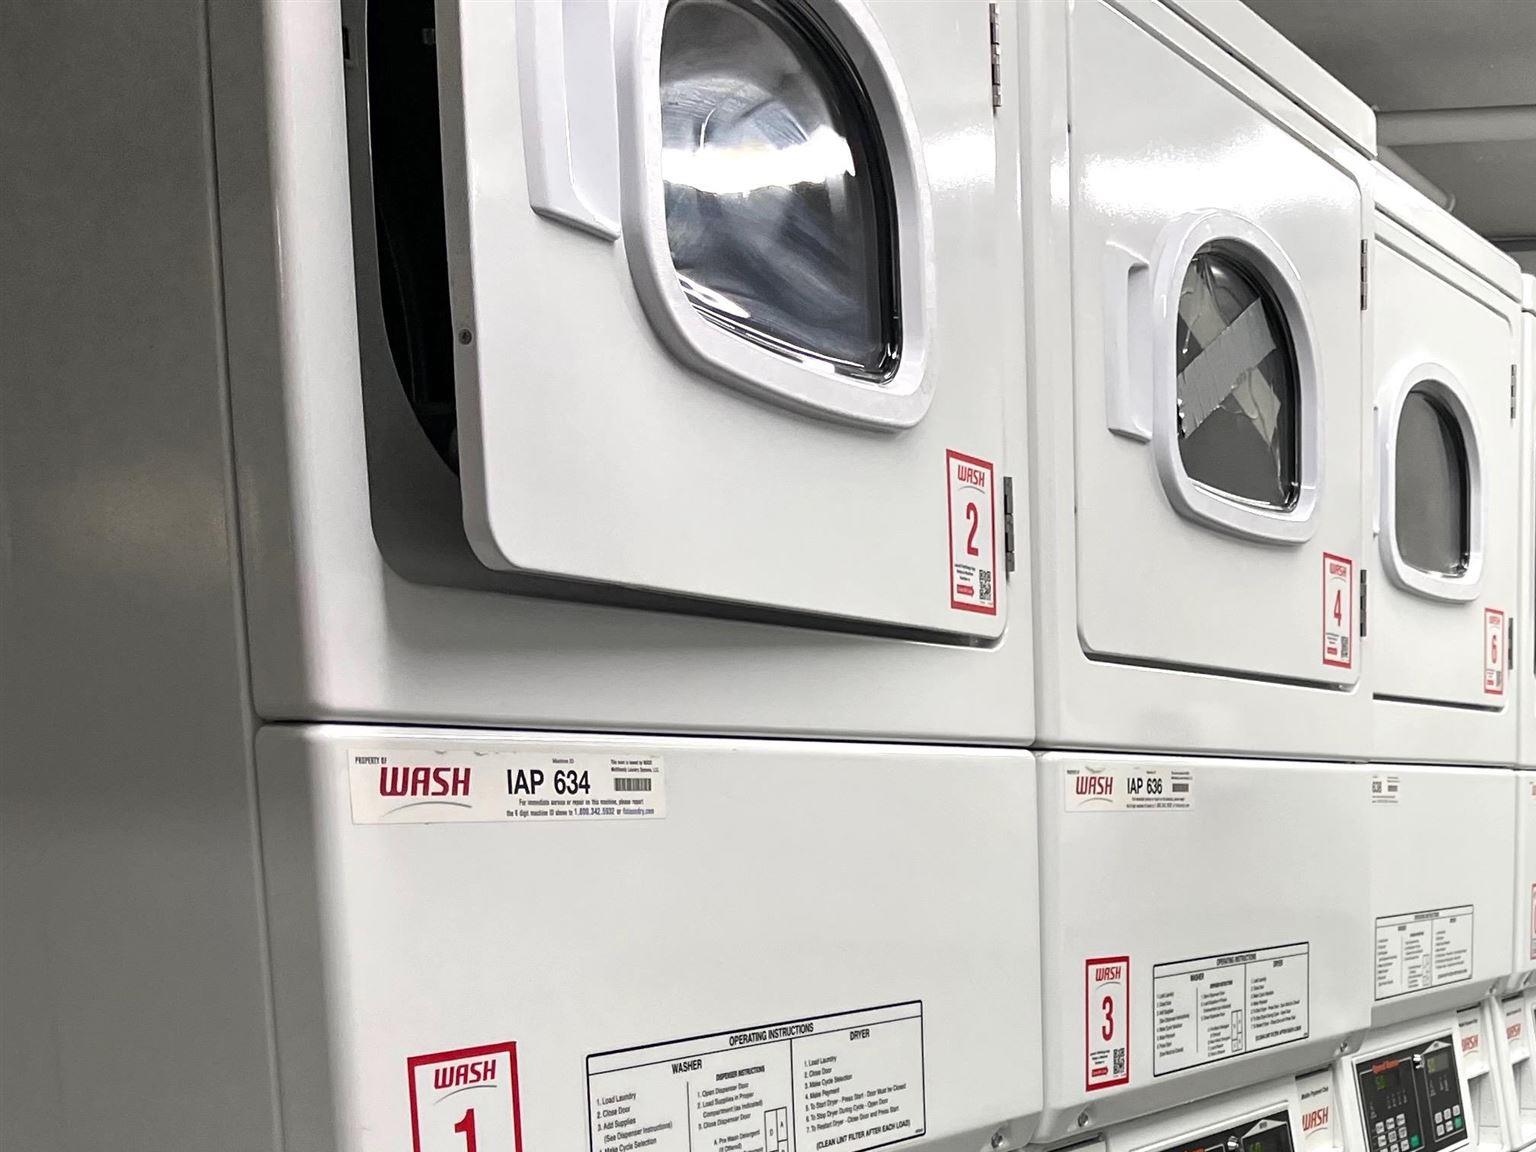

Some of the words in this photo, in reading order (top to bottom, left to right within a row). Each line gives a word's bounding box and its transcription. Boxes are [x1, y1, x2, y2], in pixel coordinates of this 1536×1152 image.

[957, 464, 985, 488] WASH
[966, 502, 979, 557] 2
[1333, 589, 1342, 627] 4
[379, 767, 471, 796] WASH
[506, 768, 545, 795] IAP
[554, 770, 591, 795] 634
[1075, 776, 1114, 795] WASH
[1127, 777, 1143, 794] IAP
[1146, 778, 1163, 795] 636
[1095, 966, 1121, 982] WASH
[1102, 996, 1114, 1042] 3
[729, 1029, 767, 1047] OPERATING
[768, 1022, 814, 1040] INSTRUCTIONS
[850, 1028, 870, 1041] DRYER
[433, 1059, 497, 1090] WASH
[671, 1059, 703, 1074] WASHER
[1302, 1106, 1328, 1131] WASH
